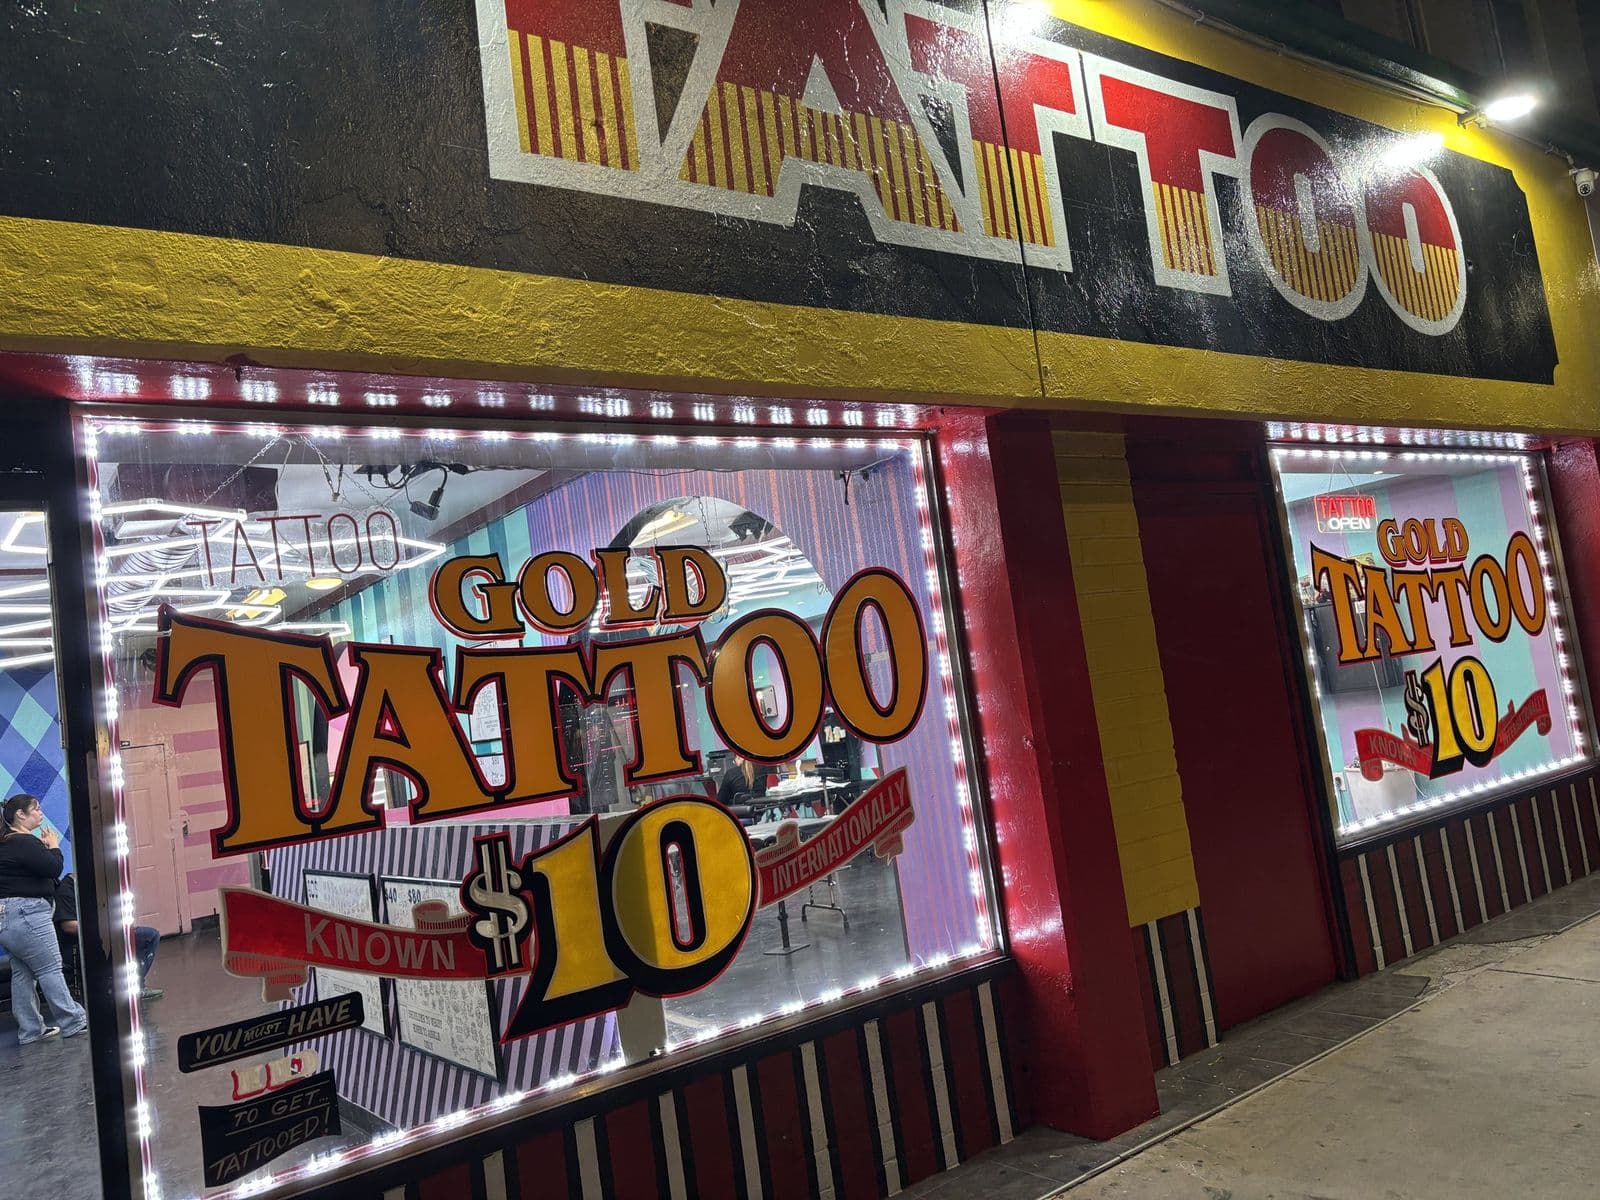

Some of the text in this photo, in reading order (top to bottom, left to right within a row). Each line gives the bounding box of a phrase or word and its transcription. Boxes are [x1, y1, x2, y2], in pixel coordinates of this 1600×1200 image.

[1316, 496, 1376, 518] TATTOO
[1329, 517, 1371, 530] OPEN
[1377, 517, 1469, 566] GOLD
[186, 511, 400, 586] TATTOO
[429, 546, 728, 638] GOLD
[1310, 531, 1547, 665] TATTOO
[152, 566, 929, 859] TATTOO
[1404, 655, 1499, 779] $10
[771, 776, 907, 894] INTERNATIONALLY
[303, 912, 455, 970] KNOWN
[460, 795, 758, 1043] $10
[194, 999, 352, 1060] YOU MUST HAVE
[208, 1106, 330, 1181] TATTOOED!
[233, 1108, 259, 1128] TO
